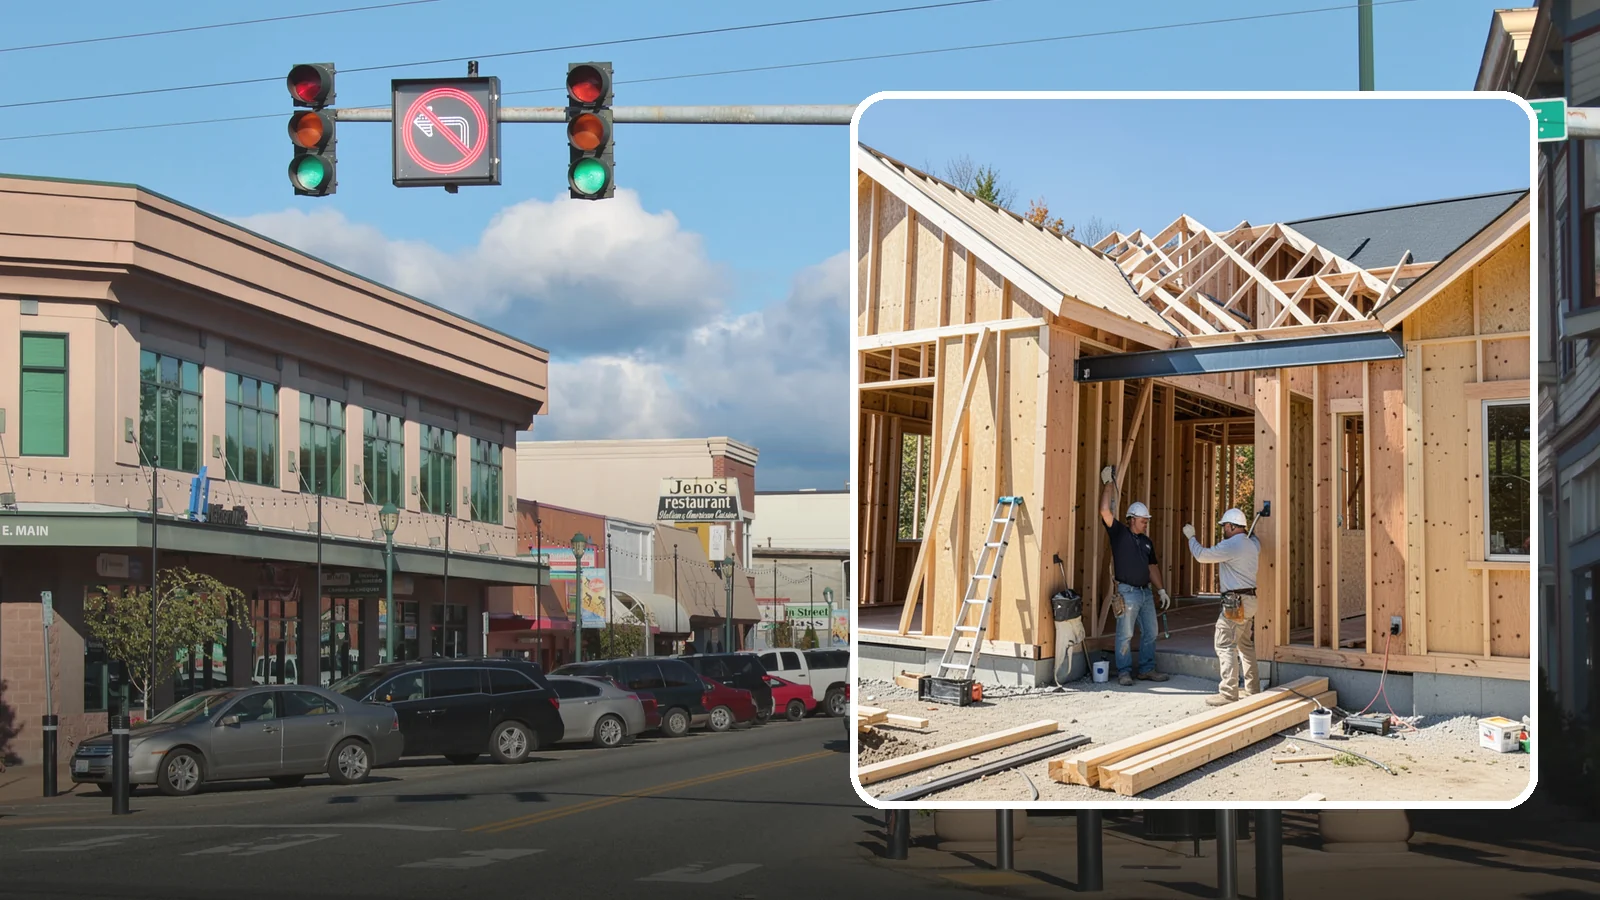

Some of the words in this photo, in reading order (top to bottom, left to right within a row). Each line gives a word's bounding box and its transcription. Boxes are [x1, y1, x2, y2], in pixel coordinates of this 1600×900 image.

[670, 480, 727, 494] Jeno's
[665, 496, 731, 509] restaurant
[659, 510, 681, 519] Italian
[686, 510, 714, 519] American
[715, 510, 737, 519] Cuisine
[2, 525, 13, 536] E.
[15, 525, 49, 536] MAIN
[797, 608, 828, 616] Street
